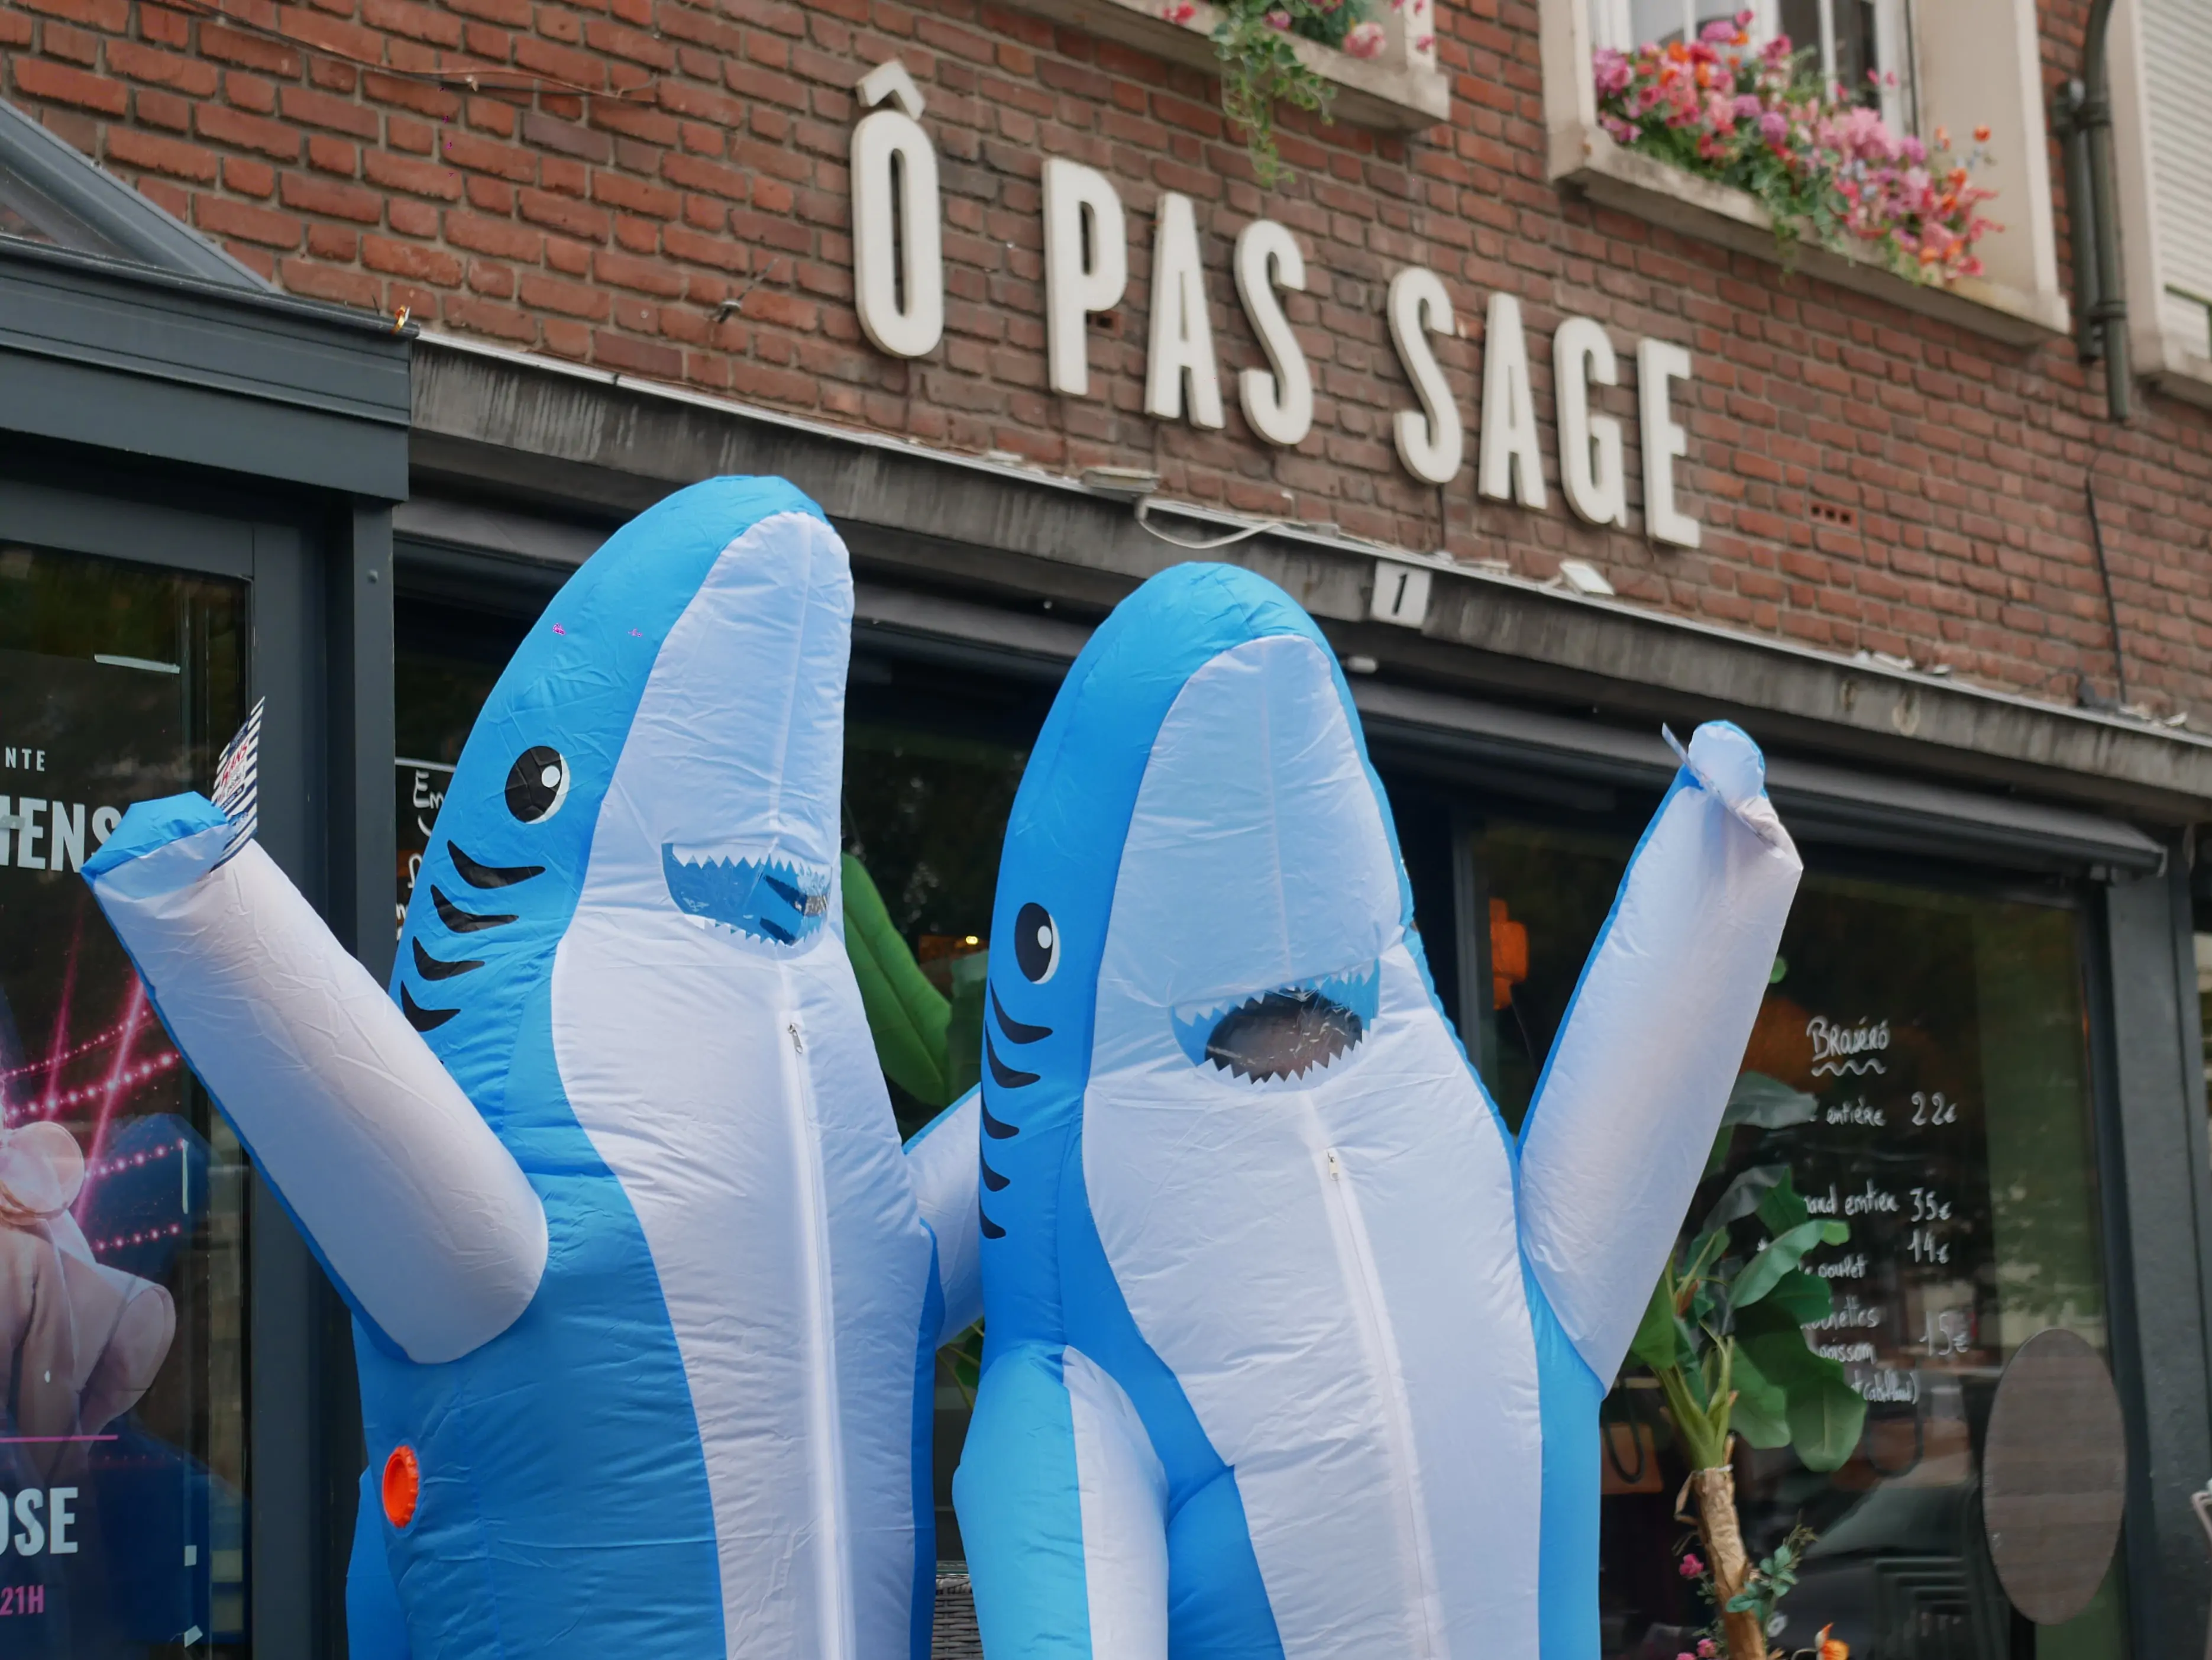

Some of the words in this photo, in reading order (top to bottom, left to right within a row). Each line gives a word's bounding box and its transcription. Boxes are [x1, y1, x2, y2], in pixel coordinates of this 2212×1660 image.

[850, 60, 945, 357] Ô
[1042, 159, 1314, 445] PAS
[1387, 266, 1702, 548] SAGE
[1392, 573, 1408, 616] 1
[5, 746, 46, 771] NTE
[0, 1584, 45, 1616] 21H
